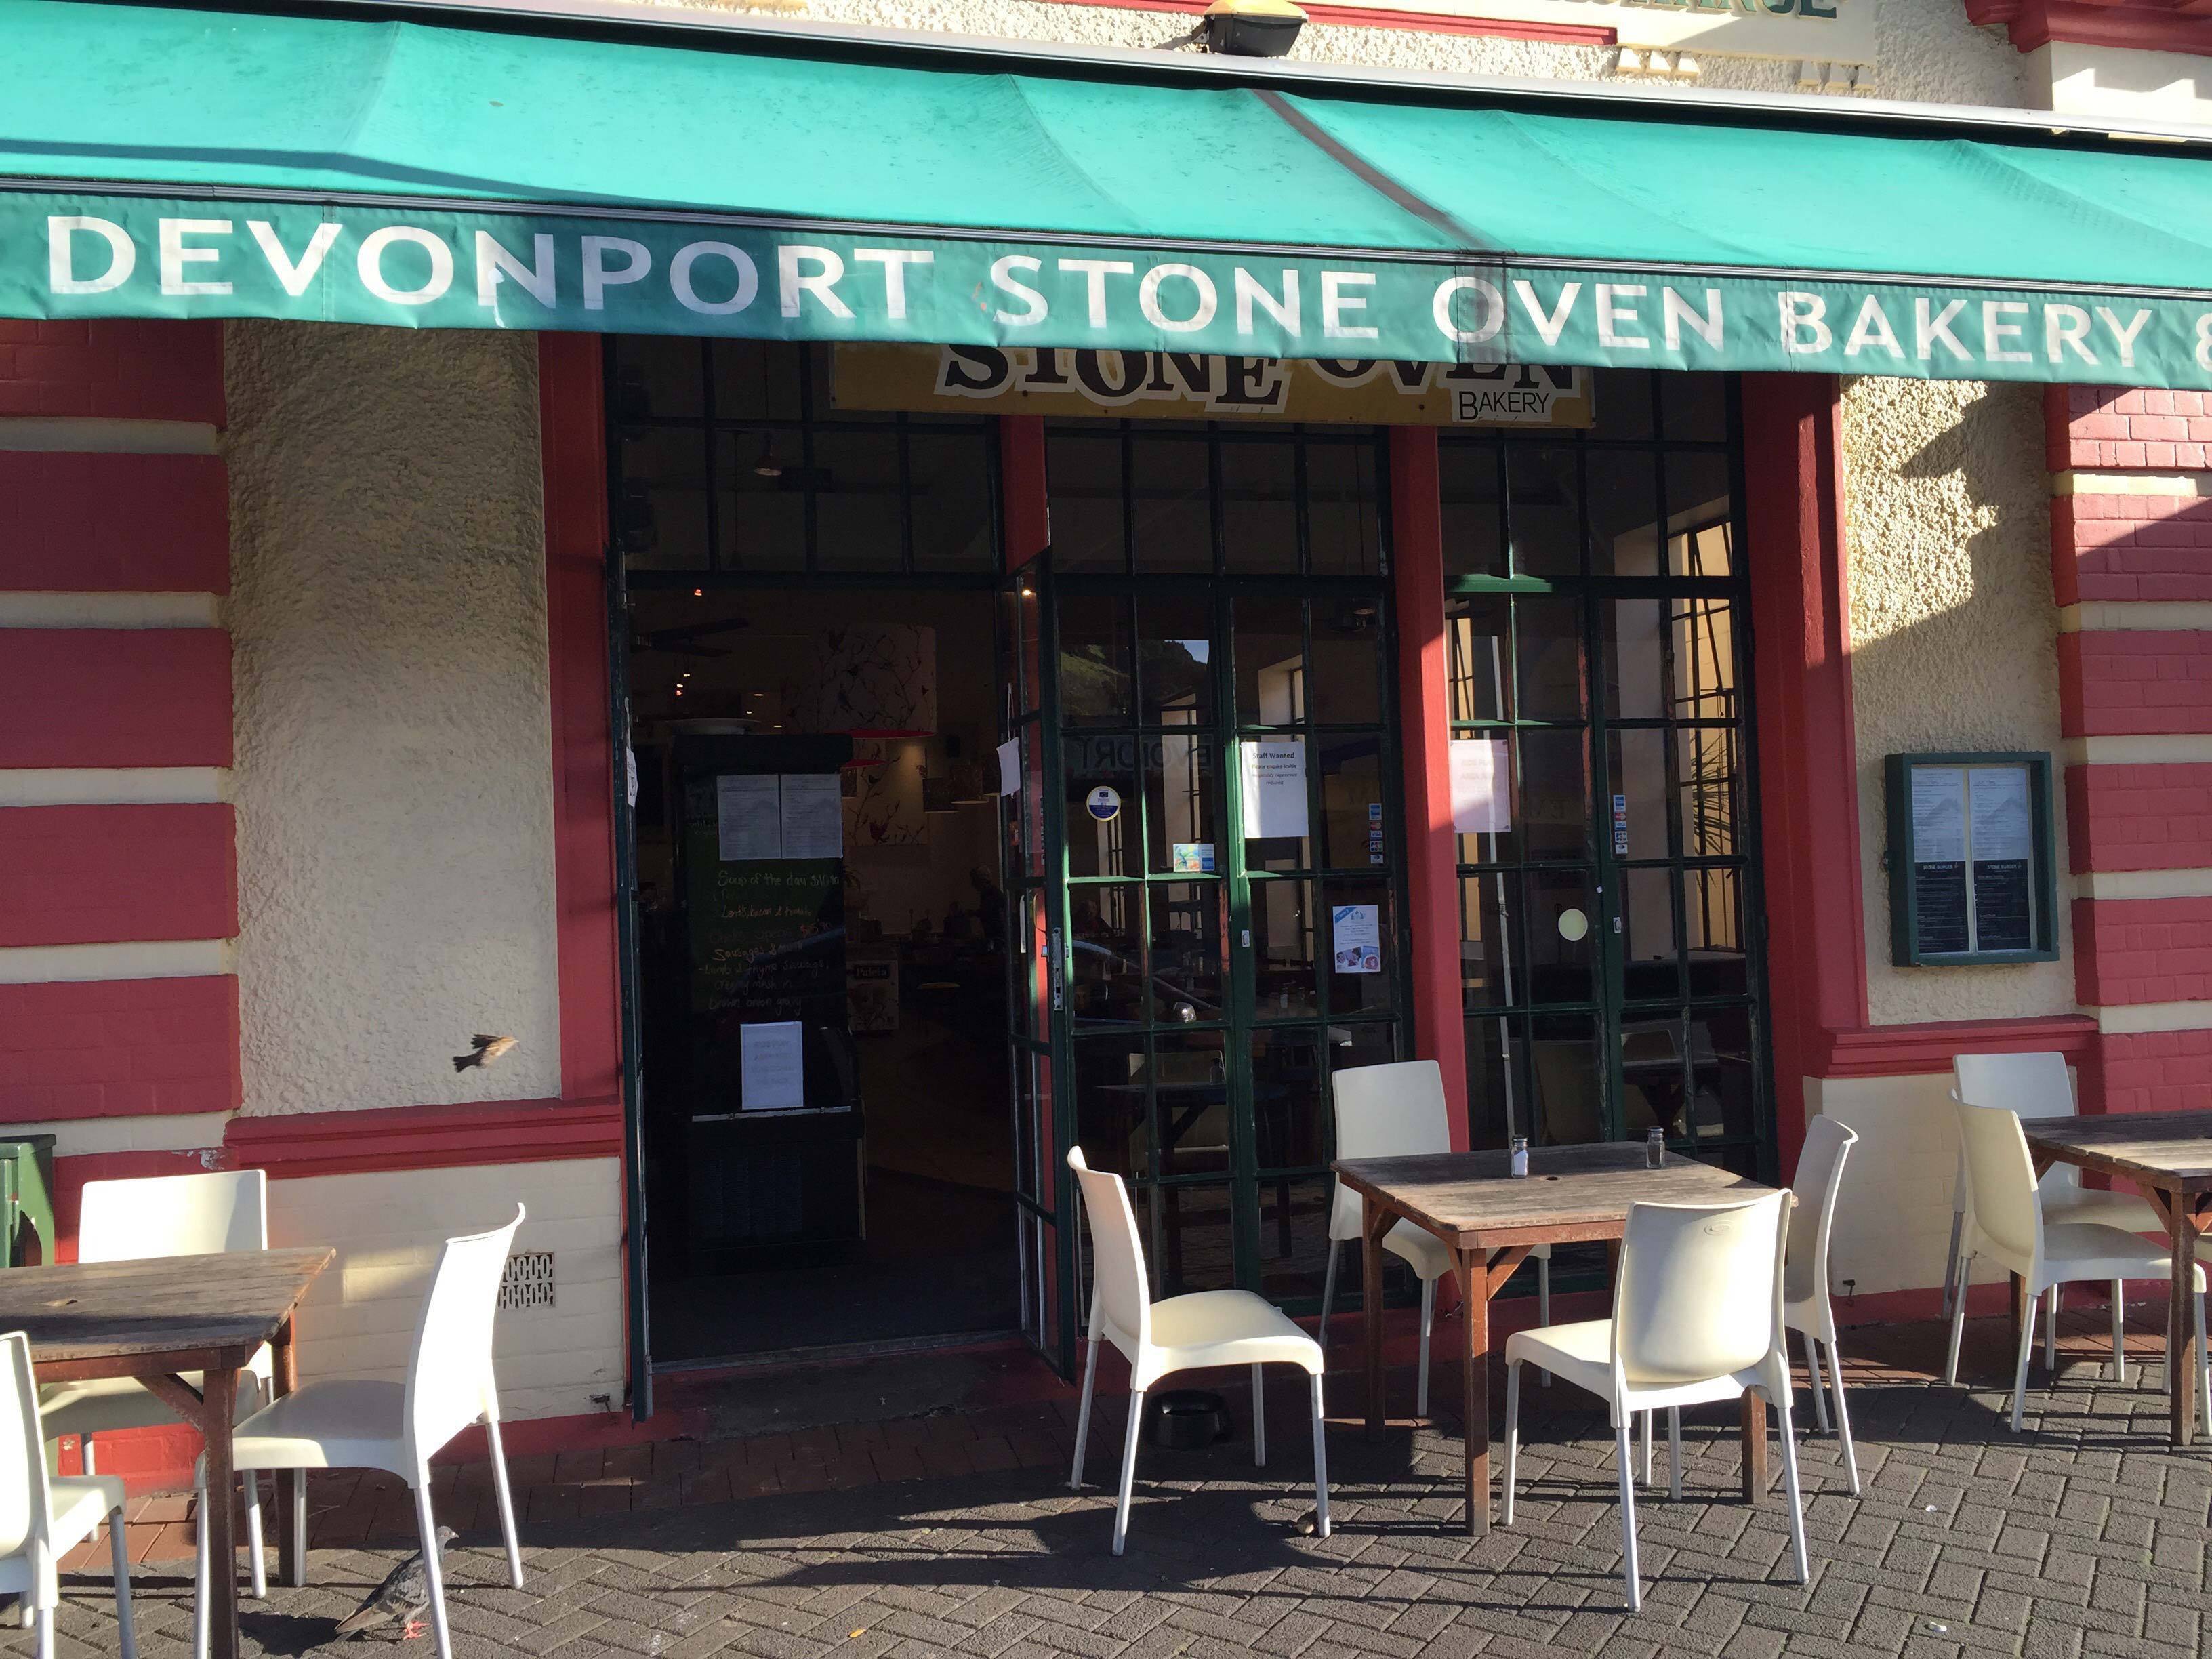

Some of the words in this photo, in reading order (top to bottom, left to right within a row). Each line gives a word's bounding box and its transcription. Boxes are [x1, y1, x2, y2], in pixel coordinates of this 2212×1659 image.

[48, 216, 935, 319] DEVONPORT
[990, 255, 1379, 339] STONE
[1432, 275, 1725, 353] OVEN
[1778, 290, 2153, 368] BAKERY
[1458, 390, 1550, 420] BAKERY
[717, 869, 747, 886] Soup
[750, 872, 762, 884] of
[764, 872, 781, 886] the
